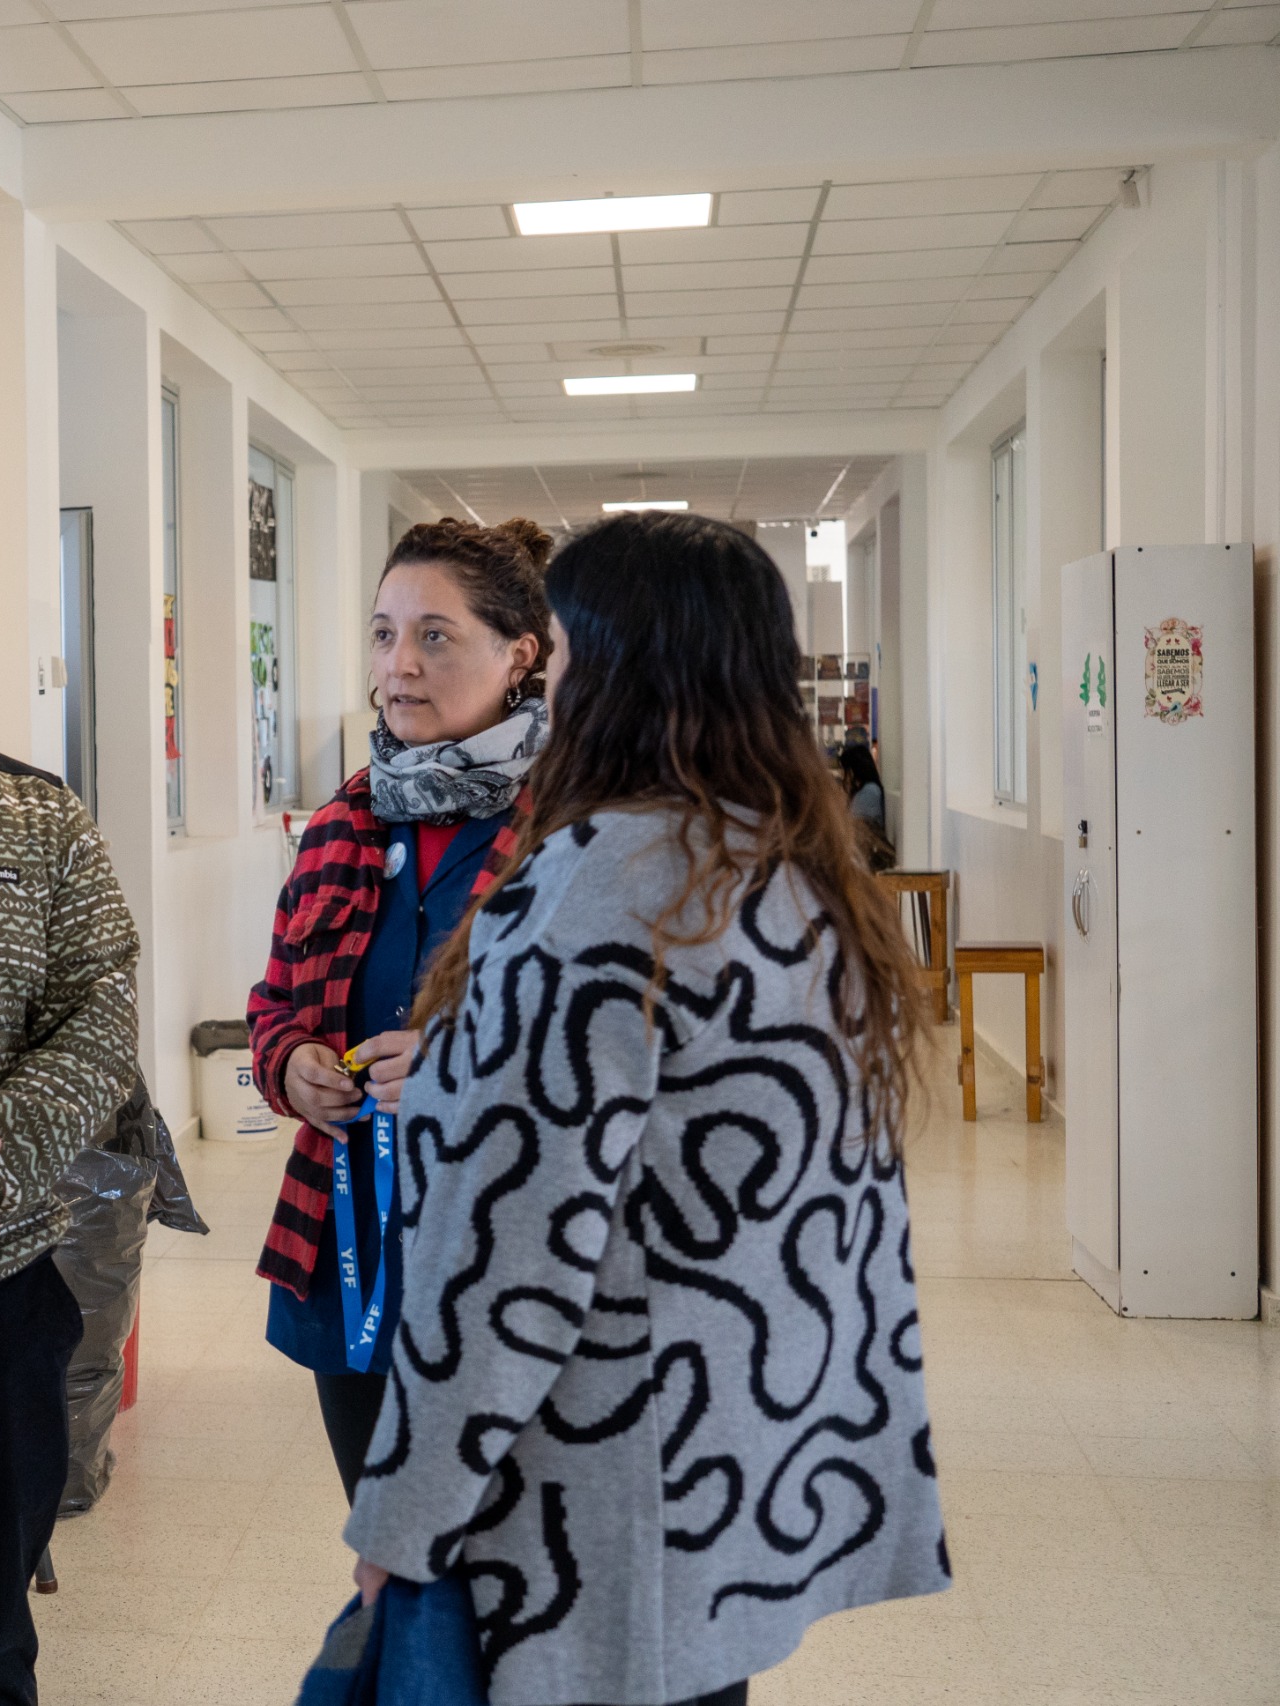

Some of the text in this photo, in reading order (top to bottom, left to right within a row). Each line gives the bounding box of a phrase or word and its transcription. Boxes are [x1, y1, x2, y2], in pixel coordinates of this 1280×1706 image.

[1157, 679, 1189, 687] LLEGAR A SER
[377, 1115, 390, 1159] YPF
[335, 1153, 349, 1195] YPF
[340, 1247, 357, 1289] YPF
[359, 1303, 381, 1345] YPF
